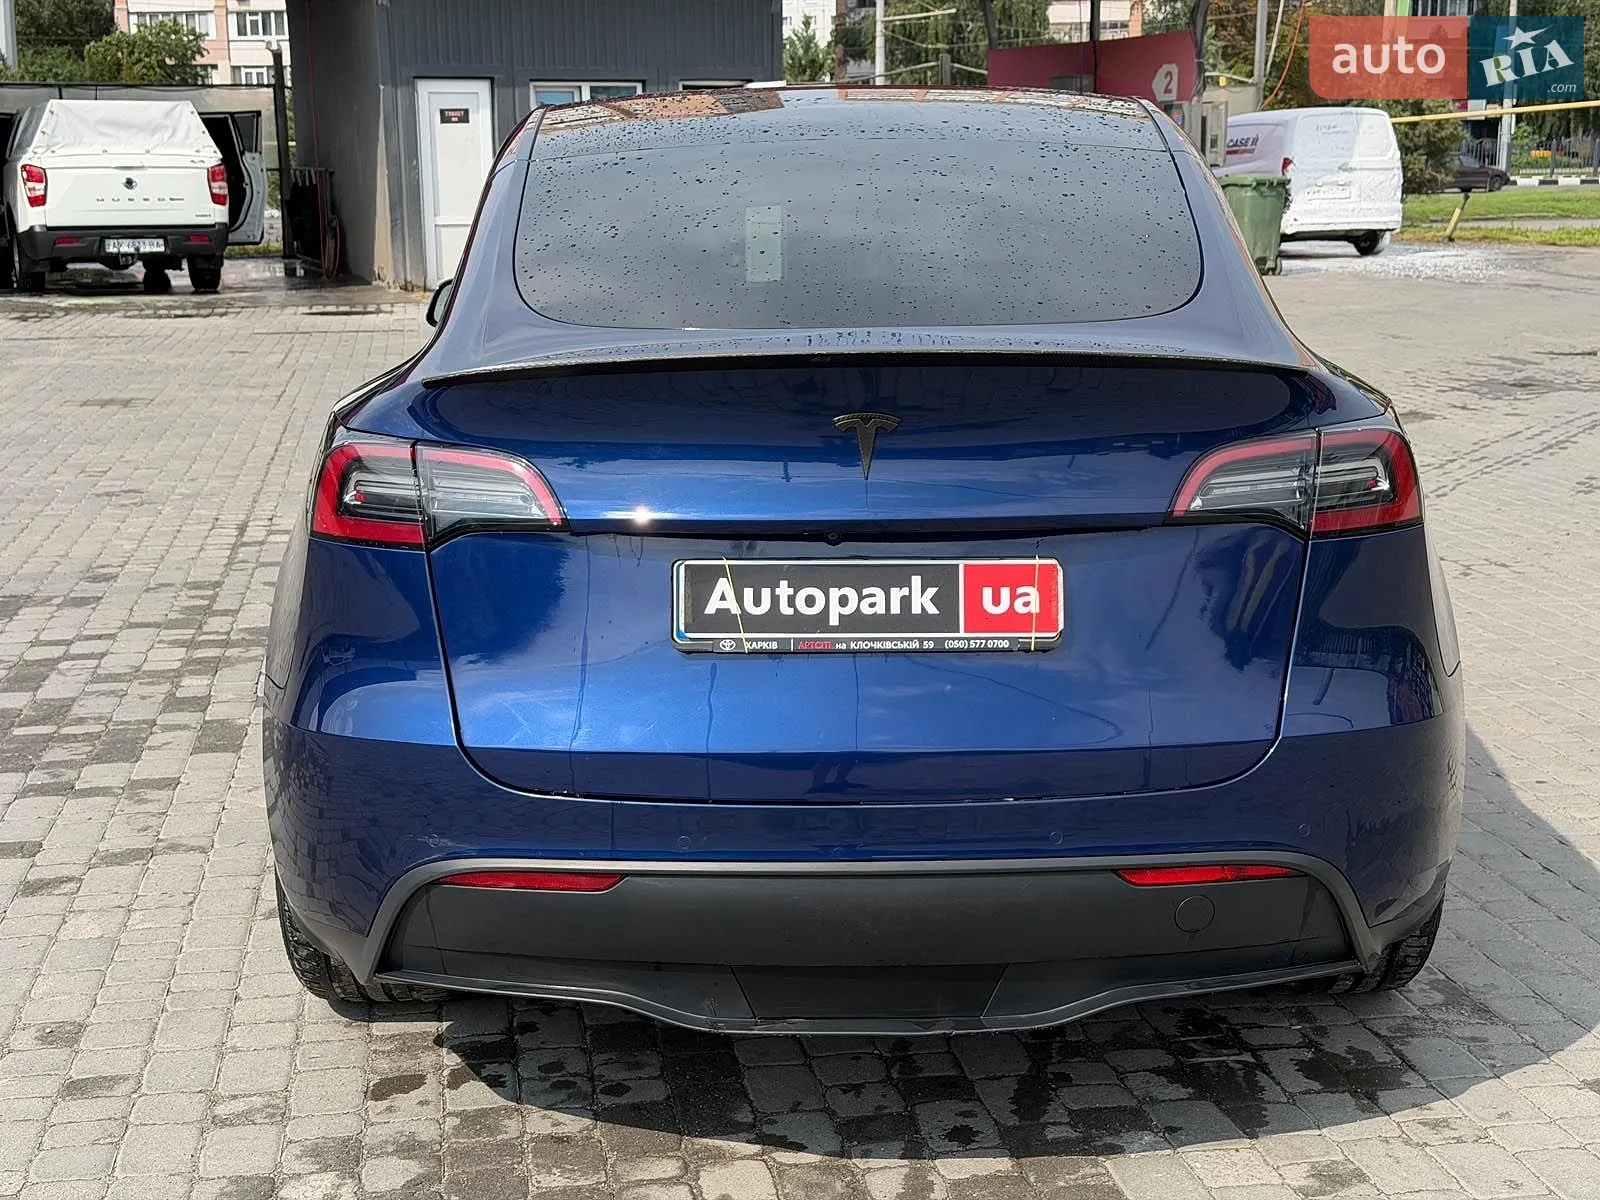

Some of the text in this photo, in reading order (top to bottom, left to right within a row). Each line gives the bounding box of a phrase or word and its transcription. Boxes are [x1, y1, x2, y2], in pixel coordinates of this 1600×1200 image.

[1163, 70, 1173, 95] 2
[703, 575, 1041, 627] Autopark ua
[745, 640, 778, 650] ХАРКІВ
[835, 642, 847, 650] на
[850, 639, 920, 650] КЛОЧКІВСЬКІЙ
[922, 640, 935, 650] 59
[944, 639, 969, 650] (050)
[969, 640, 986, 649] 577
[986, 639, 1010, 649] 0700
